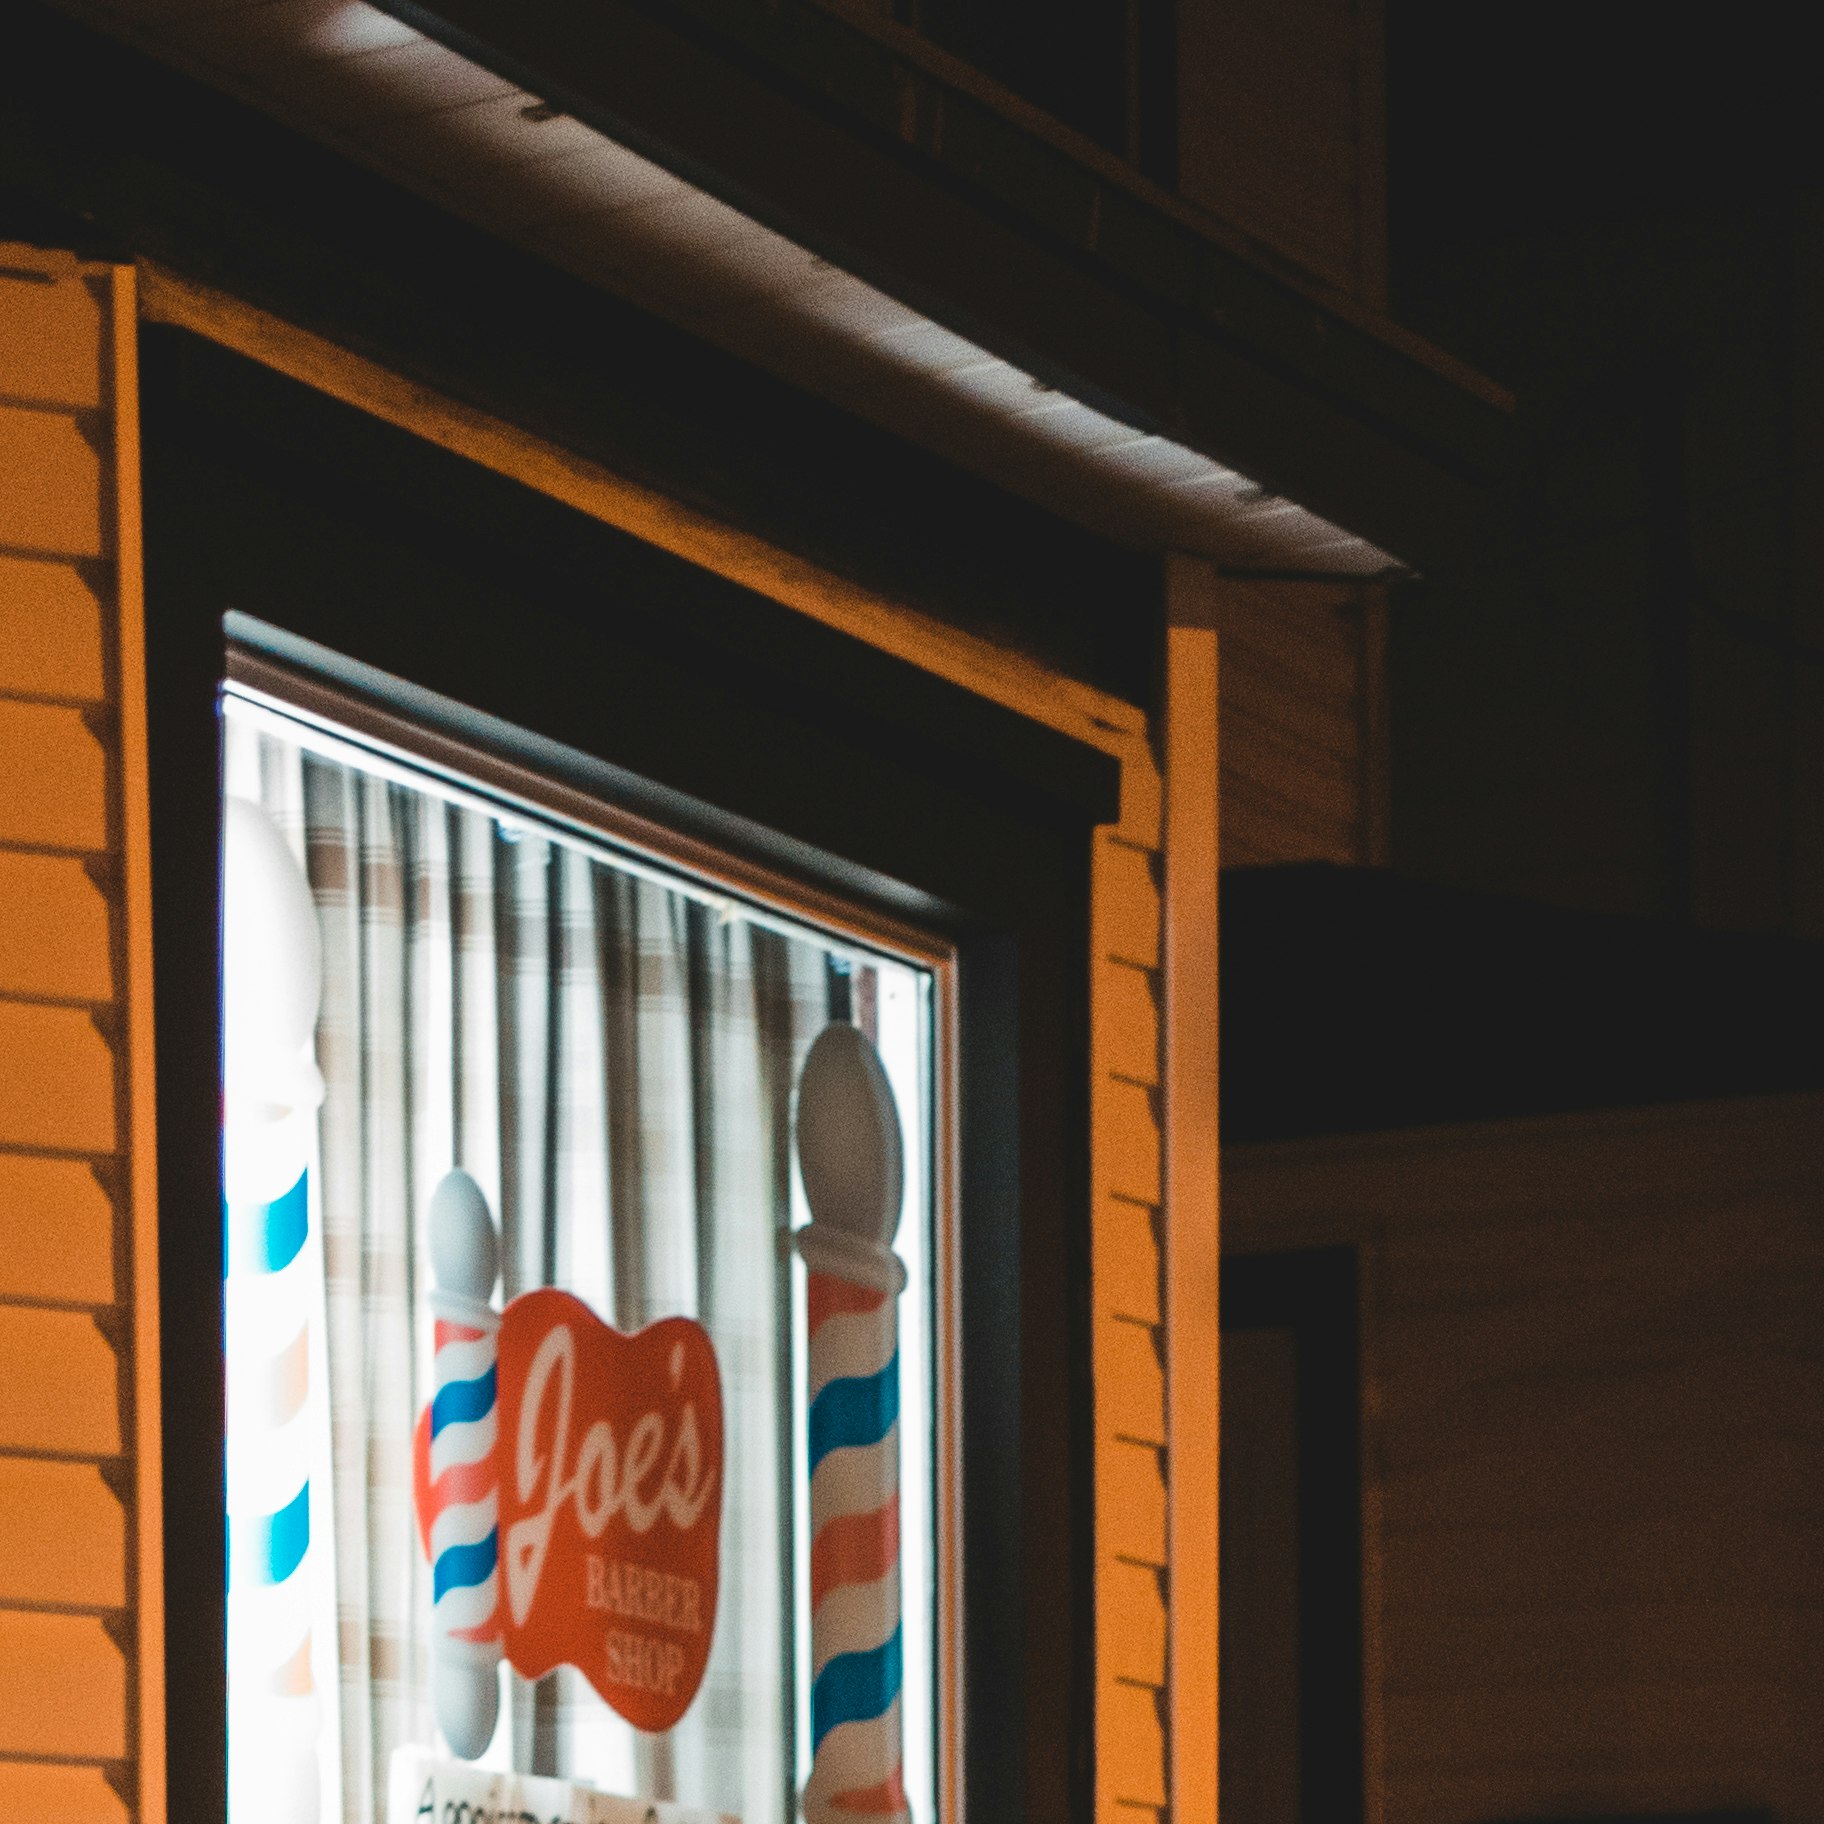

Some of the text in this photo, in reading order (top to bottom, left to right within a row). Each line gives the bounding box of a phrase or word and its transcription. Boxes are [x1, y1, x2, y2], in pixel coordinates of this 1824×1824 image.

[506, 1323, 717, 1627] Joe's
[586, 1553, 702, 1633] BARBER
[606, 1627, 685, 1697] SHOP
